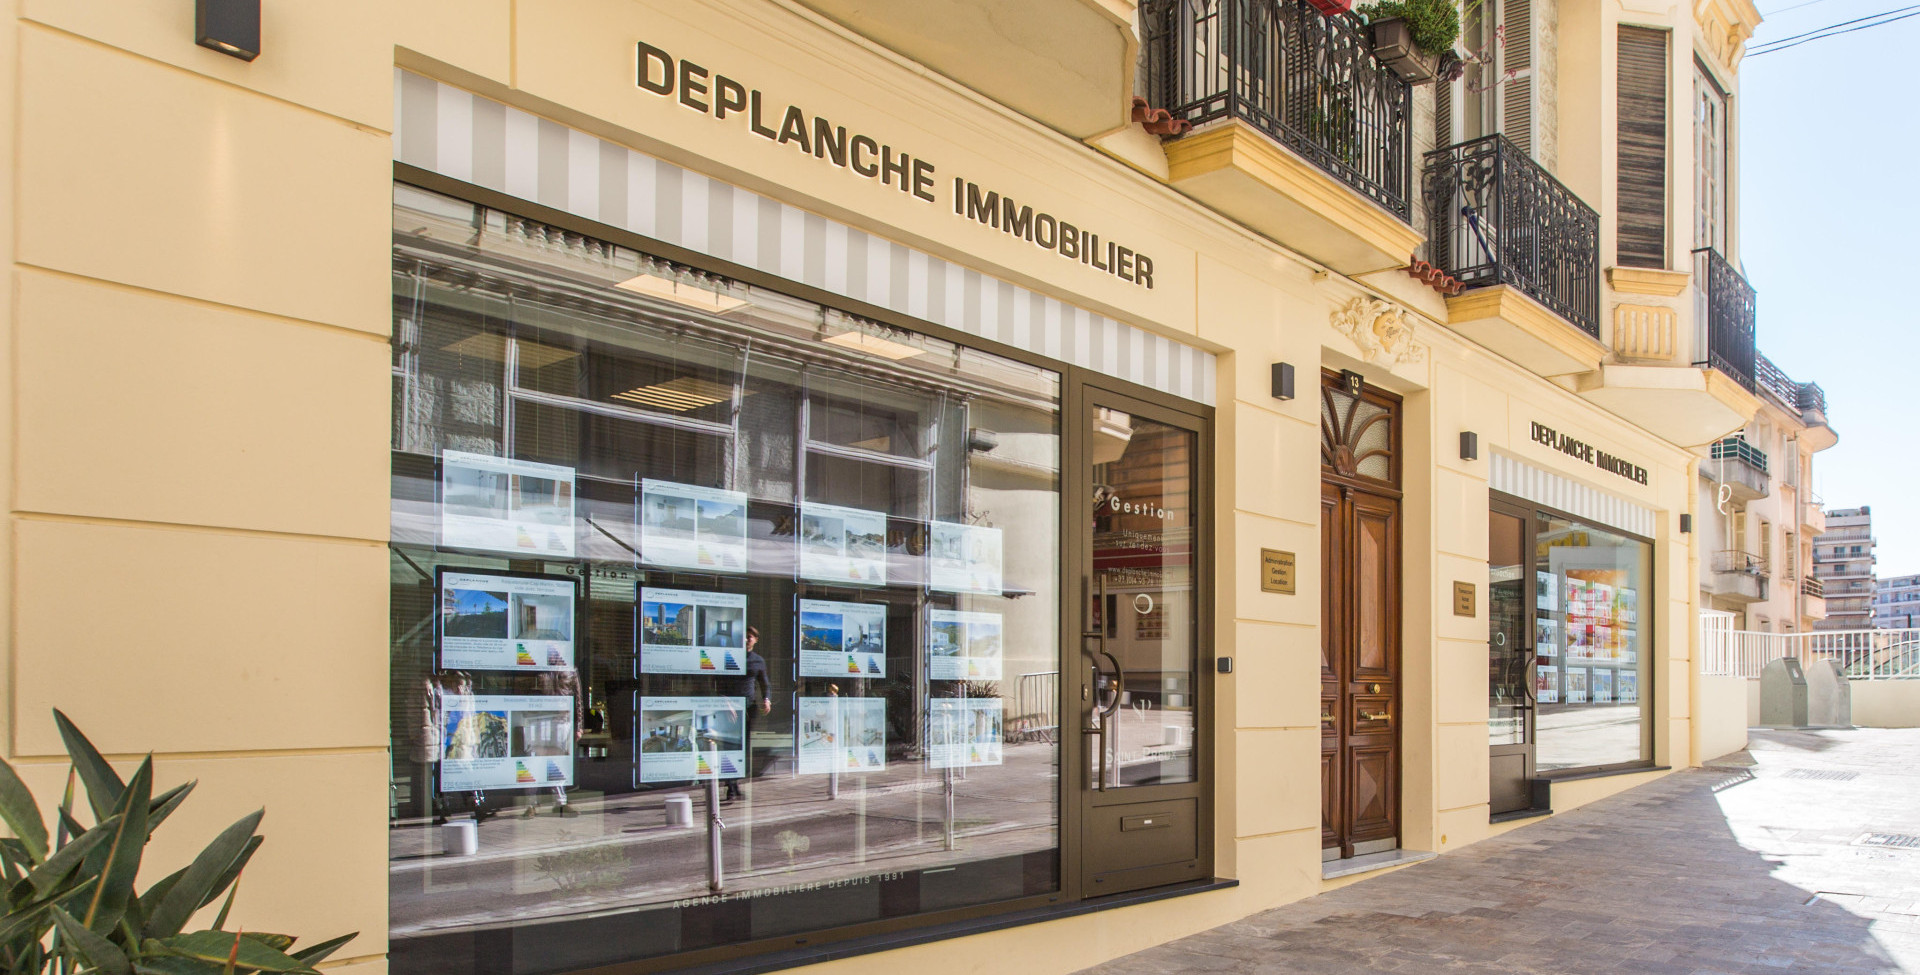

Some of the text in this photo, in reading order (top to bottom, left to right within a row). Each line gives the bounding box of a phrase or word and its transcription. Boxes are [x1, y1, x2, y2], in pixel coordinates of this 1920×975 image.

[636, 41, 1154, 289] DEPLANCHE IMMOBILIER
[1351, 376, 1359, 388] 13
[1531, 421, 1647, 486] DEPLANCHE IMMOBILIER
[1111, 496, 1174, 520] Gestion
[673, 894, 728, 909] AGENCE
[828, 875, 870, 889] DEPUIS
[878, 871, 904, 881] 1991
